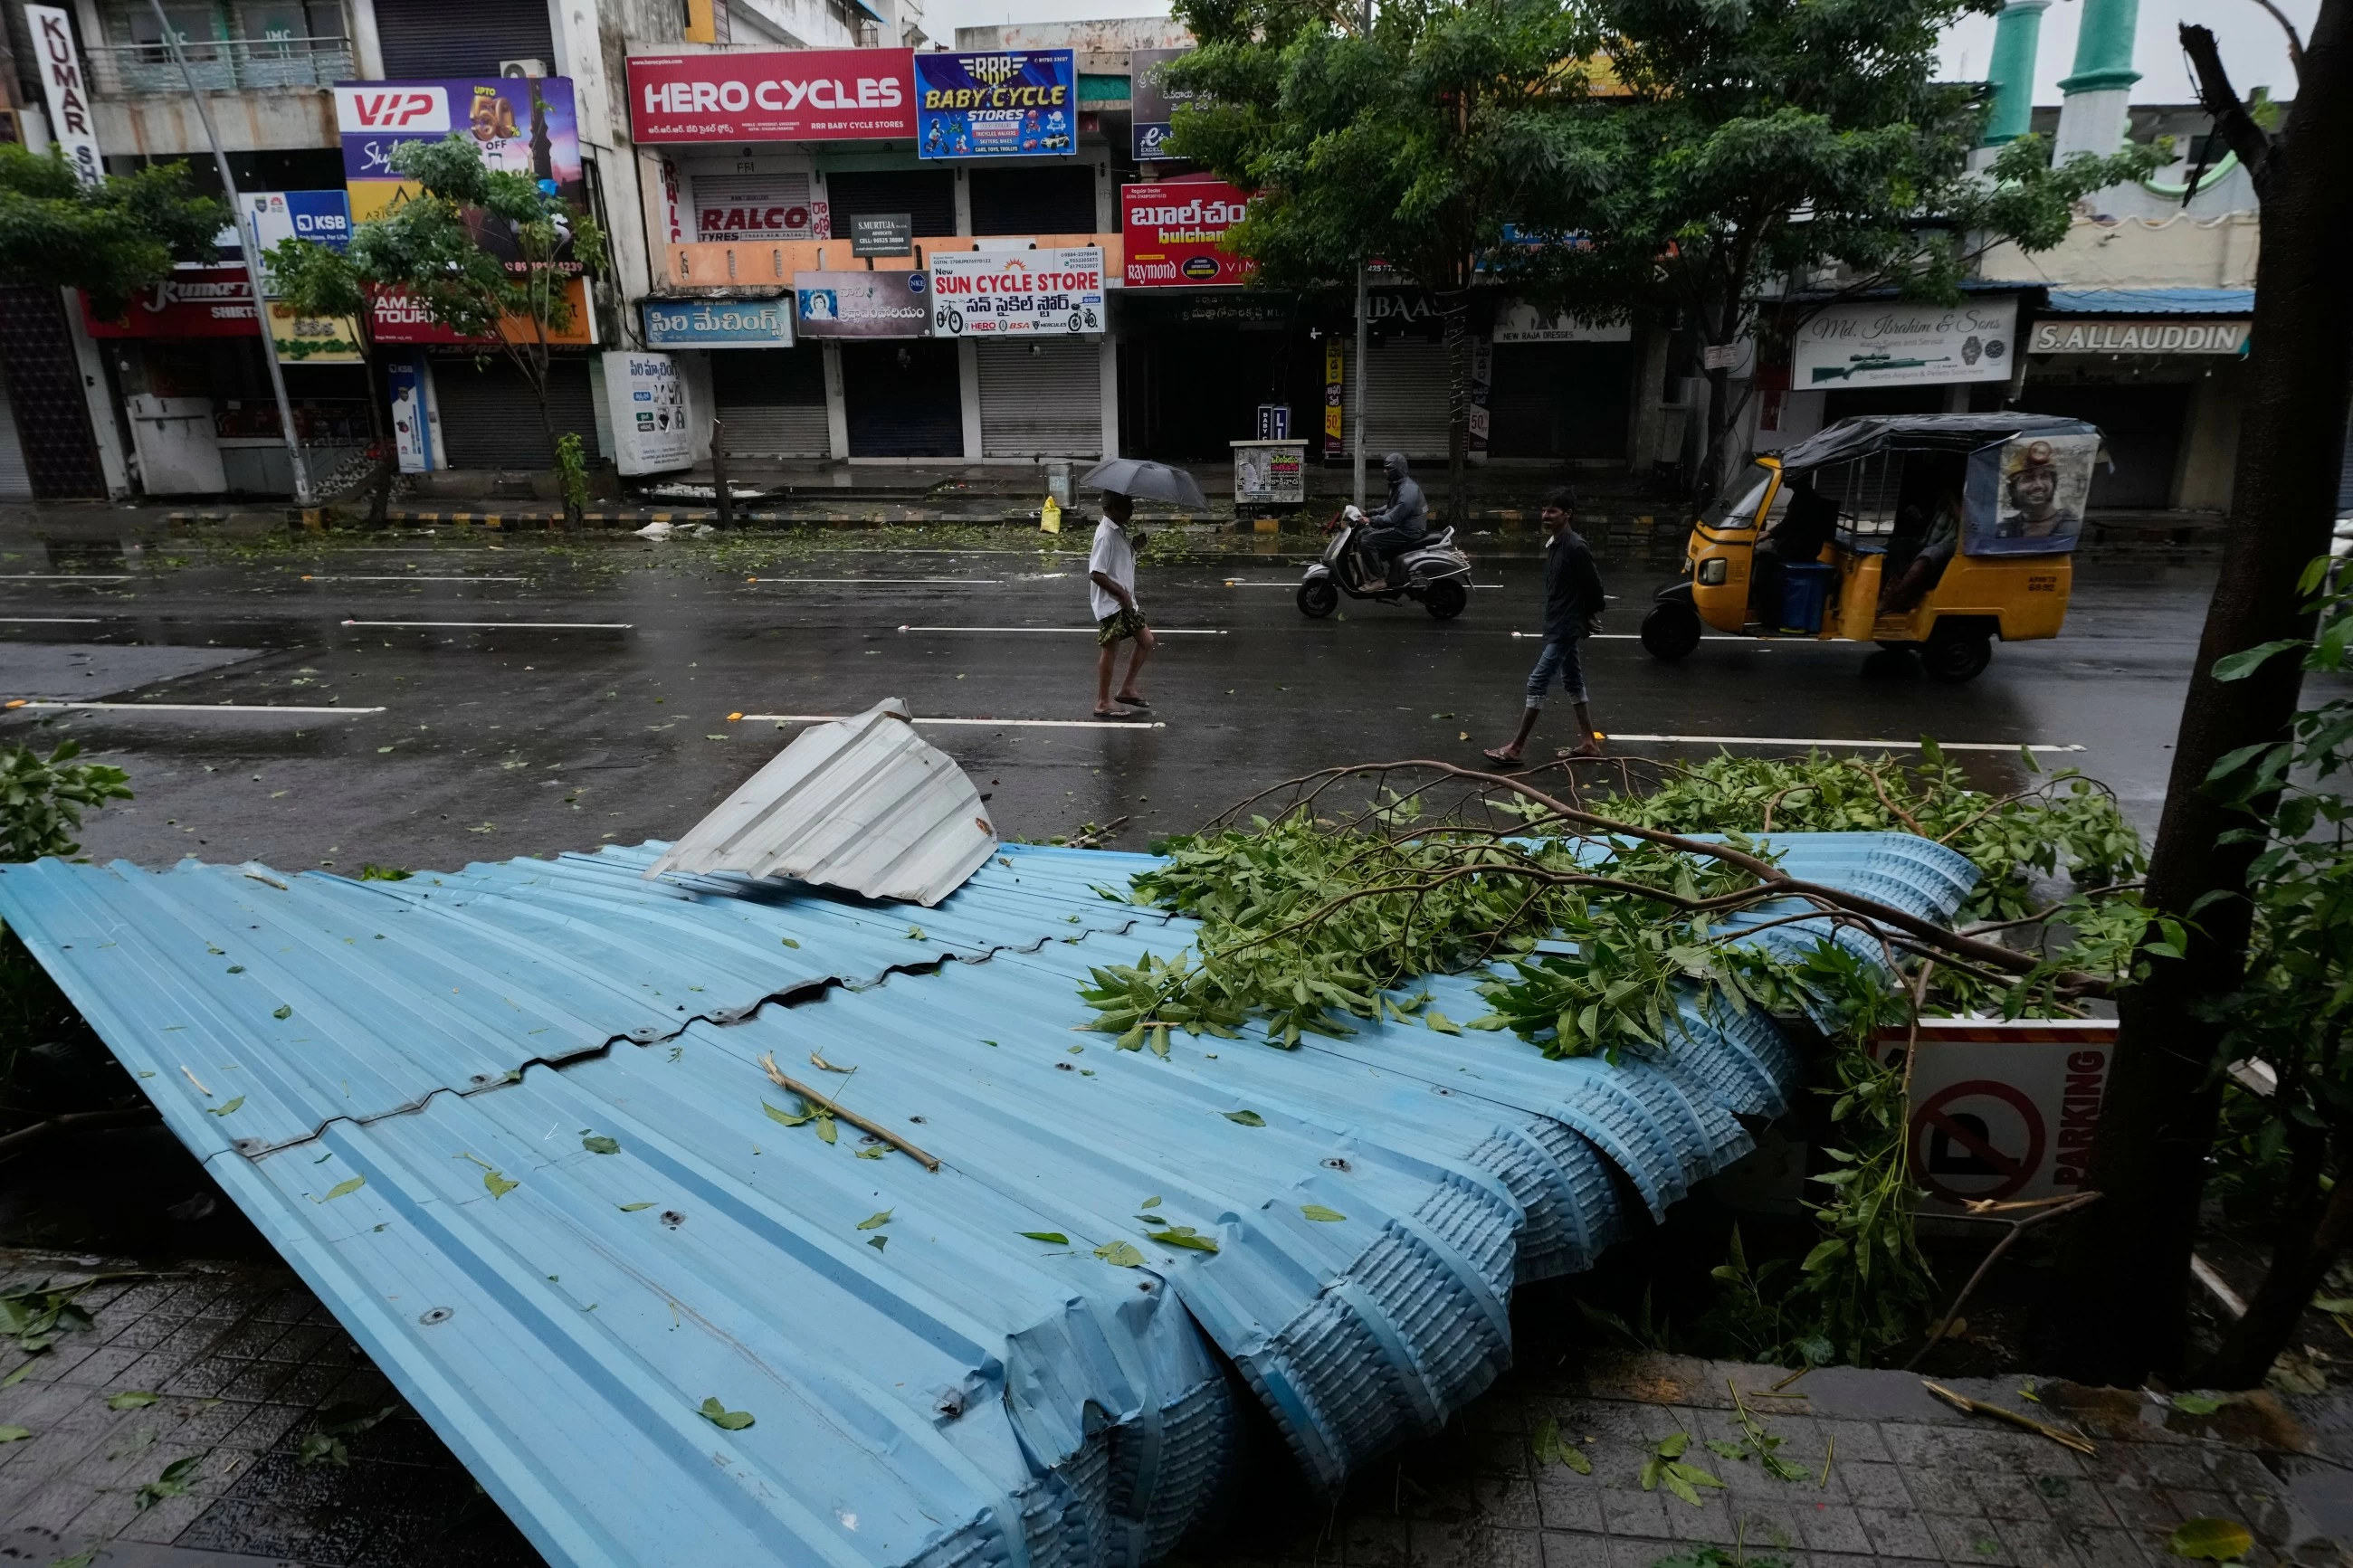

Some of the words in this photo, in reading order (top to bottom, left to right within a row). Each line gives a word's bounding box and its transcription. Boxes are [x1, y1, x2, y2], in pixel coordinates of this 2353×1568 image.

[39, 14, 90, 136] KUMAR
[975, 56, 1012, 84] RRR
[473, 86, 496, 97] UPTO
[644, 81, 750, 113] HERO
[755, 77, 903, 110] CYCLES
[925, 88, 987, 109] BABY
[992, 85, 1068, 107] CYCLE
[354, 94, 433, 126] VIP
[967, 109, 1025, 121] STORES
[485, 139, 507, 151] OFF
[314, 215, 346, 230] KSB
[701, 206, 809, 231] RALCO
[858, 221, 895, 230] S.MURTUJA
[700, 232, 739, 242] TYRES
[936, 275, 972, 295] SUN
[976, 273, 1033, 293] CYCLE
[1038, 271, 1099, 291] STORE
[966, 296, 992, 313] సన్
[996, 295, 1034, 317] సైకిల్
[1037, 294, 1070, 318] స్టోర్
[651, 311, 689, 333] సిరి
[970, 322, 996, 330] HERO
[1812, 317, 1857, 339] Md.
[1862, 313, 1931, 339] Ibrahim
[1936, 313, 1954, 333] &
[1956, 309, 2000, 333] Sons
[1503, 332, 1519, 341] NEW
[1521, 331, 1540, 340] RAJA
[1543, 331, 1574, 339] DRESSES
[2037, 324, 2238, 349] S.ALLAUDDIN
[1326, 414, 1338, 429] 50
[1472, 414, 1483, 429] 50
[2053, 1050, 2105, 1186] PARKING
